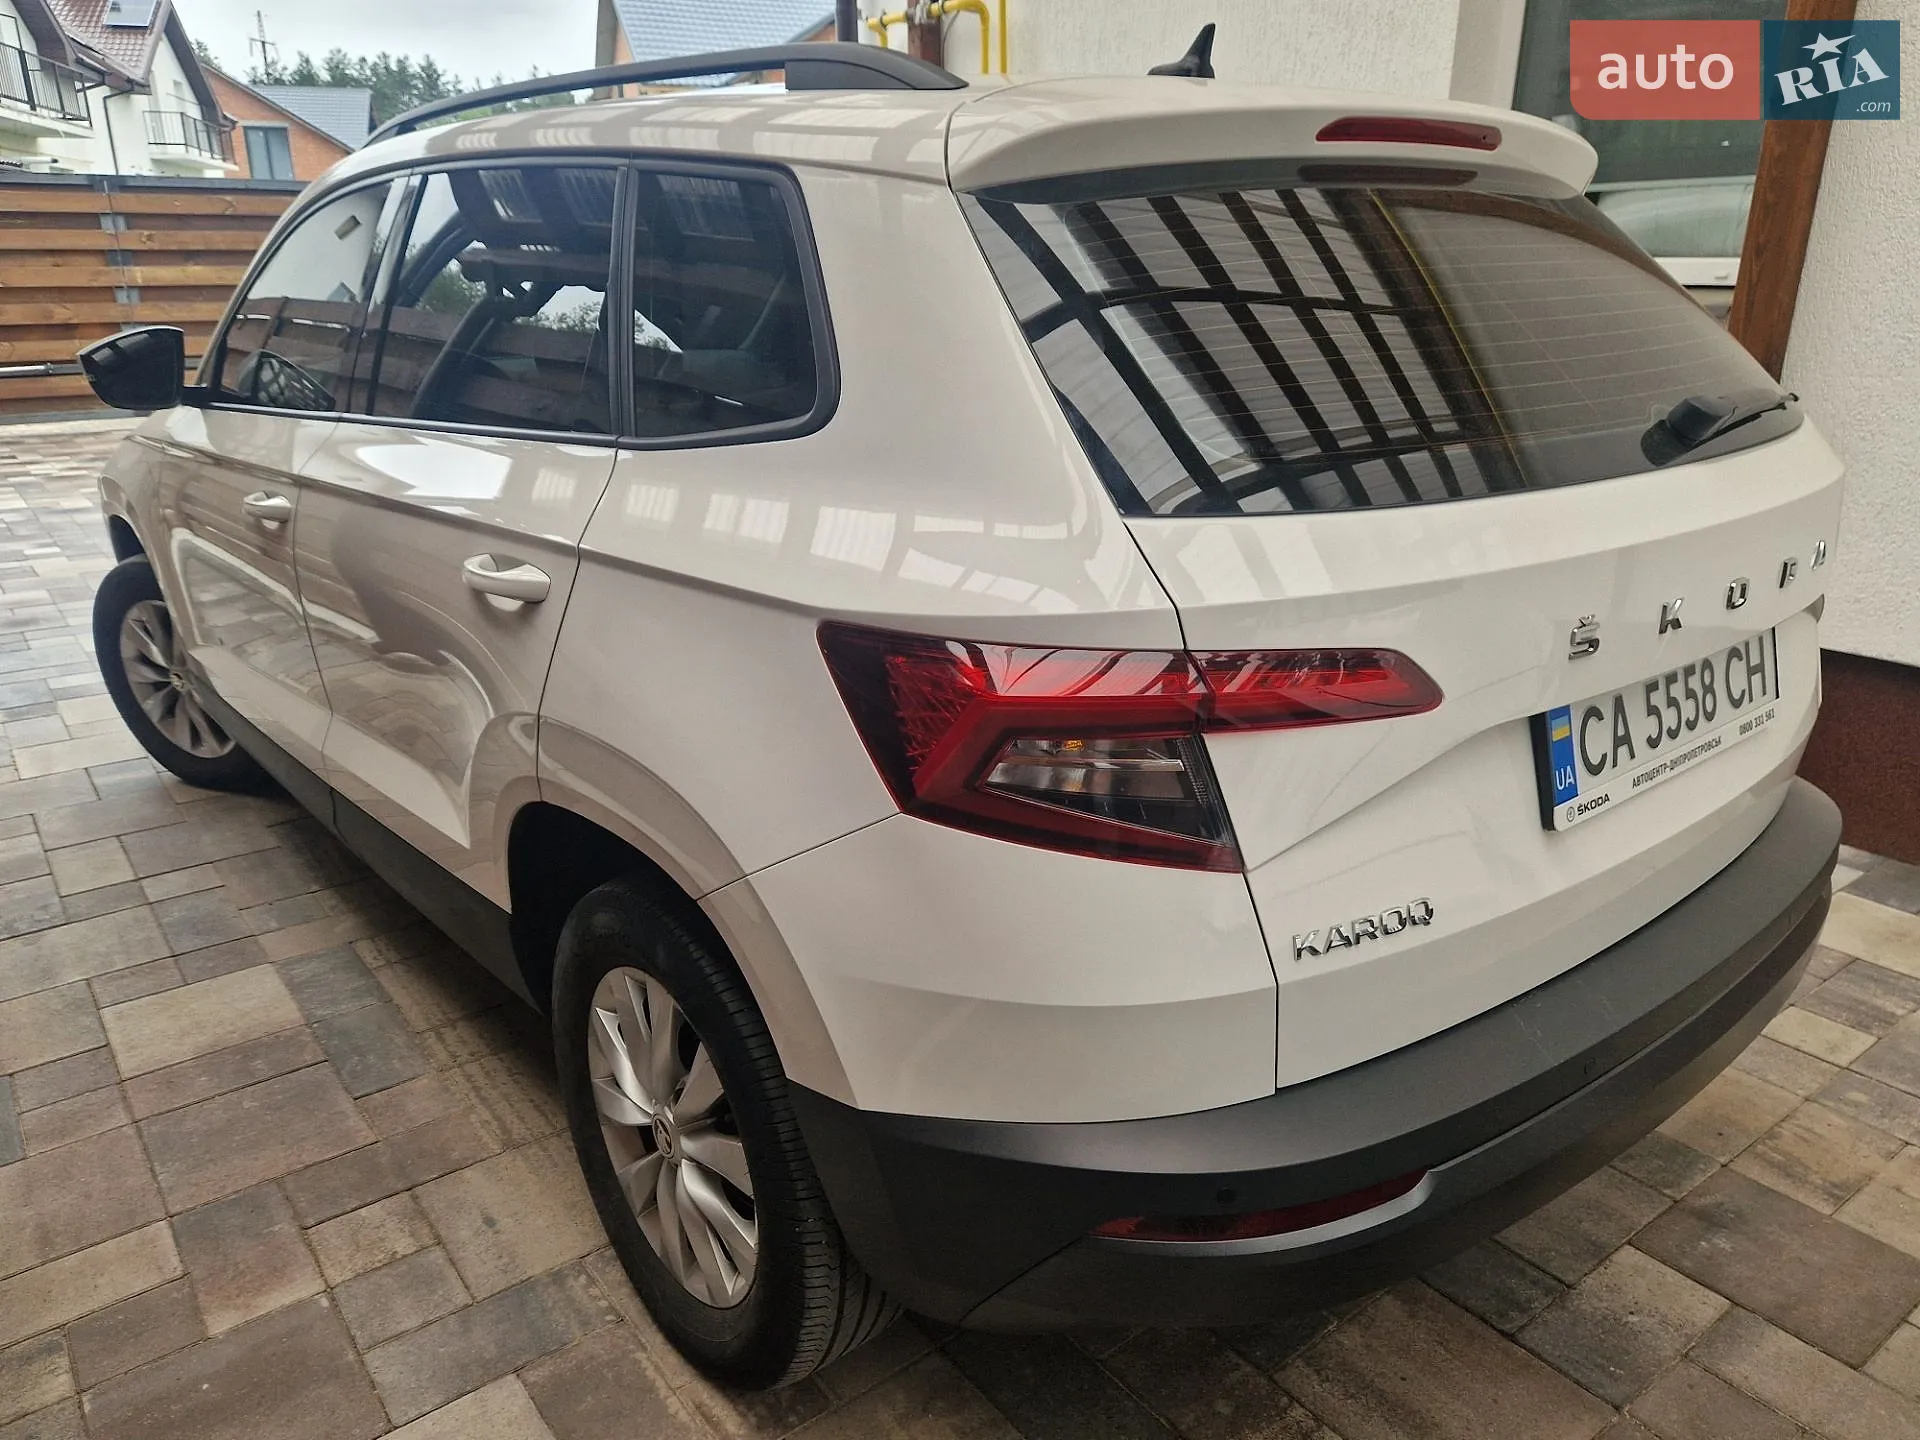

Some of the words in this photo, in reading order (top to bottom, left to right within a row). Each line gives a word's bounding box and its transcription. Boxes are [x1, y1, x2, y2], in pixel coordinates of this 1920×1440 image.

[1579, 693, 1636, 776] CA
[1644, 657, 1717, 749] 5558
[1725, 635, 1767, 709] CH
[1555, 765, 1575, 790] UA
[1577, 793, 1610, 816] ŠKODA
[1293, 896, 1434, 961] KAROQ
